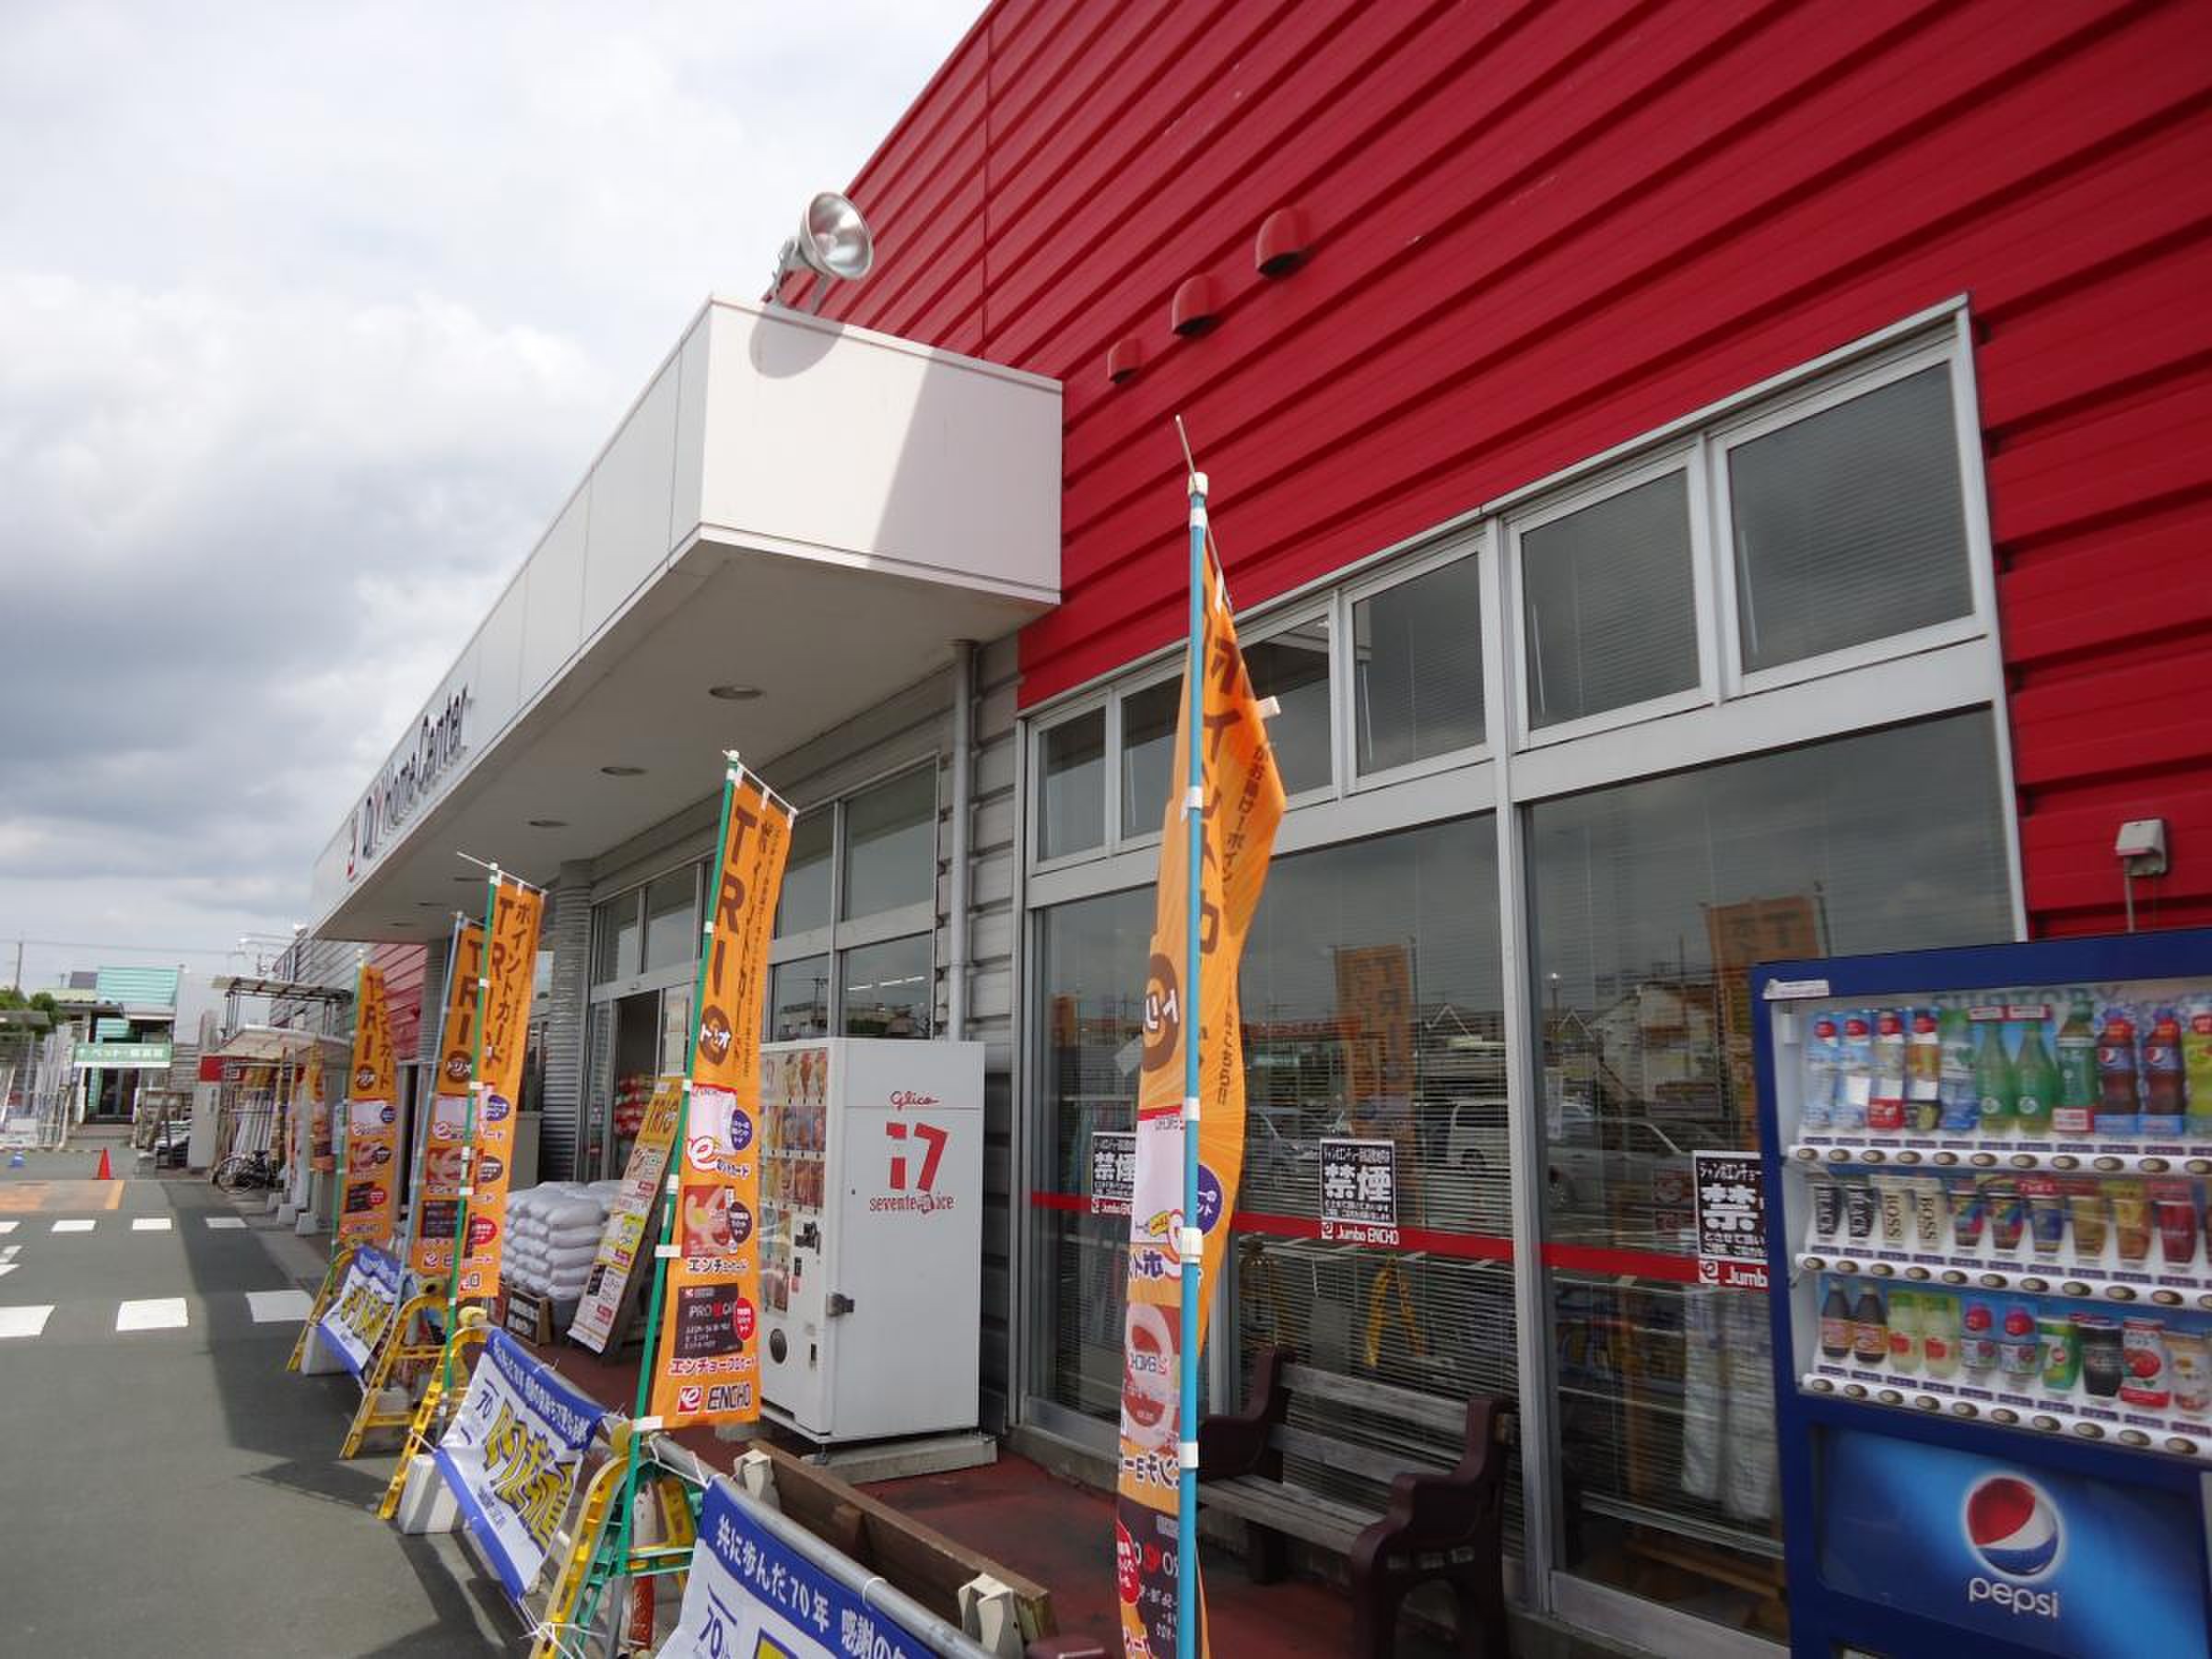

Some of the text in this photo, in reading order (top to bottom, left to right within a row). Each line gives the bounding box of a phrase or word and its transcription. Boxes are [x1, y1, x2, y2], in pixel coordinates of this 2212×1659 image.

[890, 1091, 940, 1112] Glico
[1324, 1163, 1392, 1201] 禁煙
[1700, 1182, 1764, 1231] 禁
[1336, 1224, 1400, 1245] Jumbo ENCHO
[1726, 1265, 1769, 1287] Jumb
[707, 1383, 752, 1410] ENCHO
[717, 1513, 830, 1634] 共に歩んだ70年
[1968, 1577, 2059, 1618] pepsi
[841, 1607, 907, 1659] 感謝の
